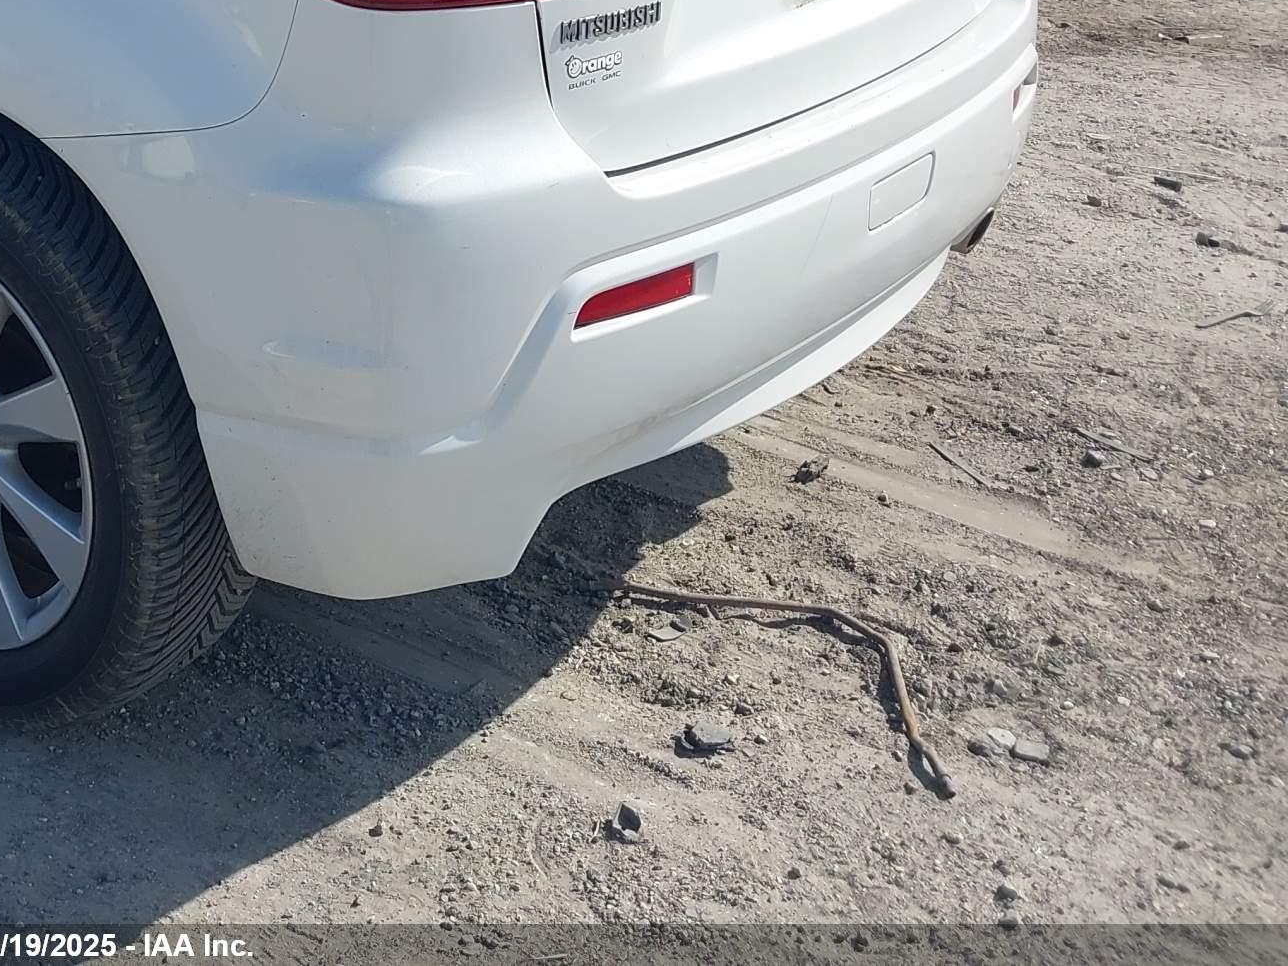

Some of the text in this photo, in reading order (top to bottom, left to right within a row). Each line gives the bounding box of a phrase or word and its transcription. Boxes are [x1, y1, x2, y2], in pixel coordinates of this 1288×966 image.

[559, 0, 662, 45] MITSUBISHI
[565, 51, 623, 79] Orange
[568, 70, 622, 91] BUICK GMC
